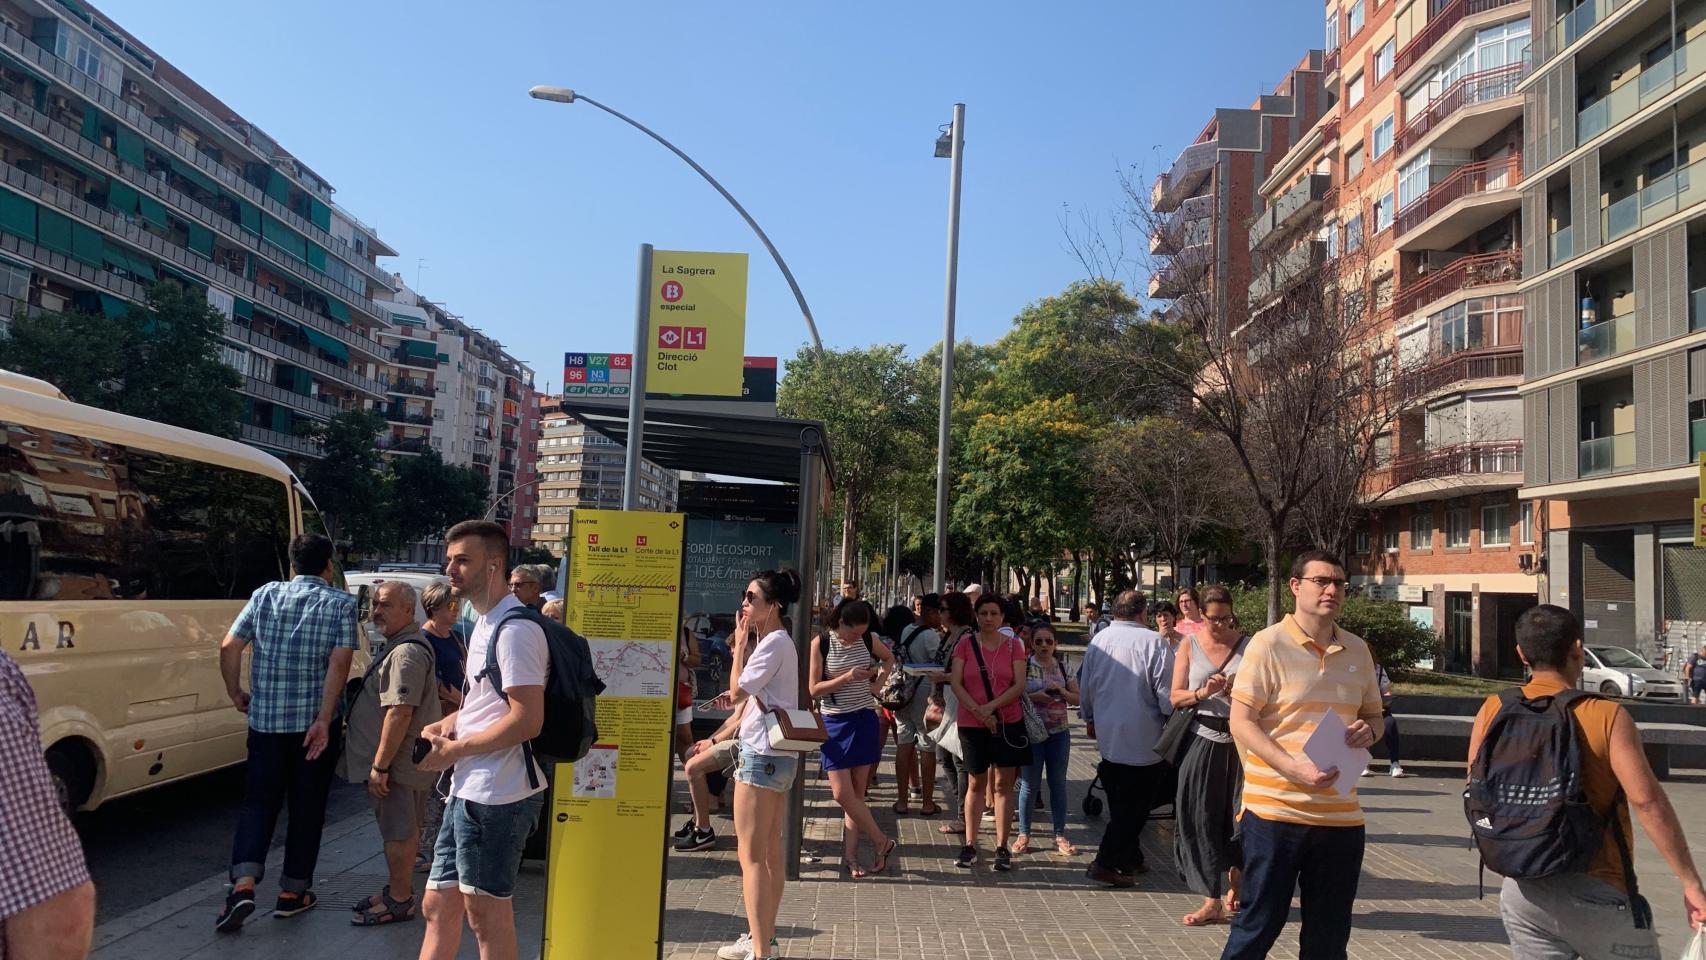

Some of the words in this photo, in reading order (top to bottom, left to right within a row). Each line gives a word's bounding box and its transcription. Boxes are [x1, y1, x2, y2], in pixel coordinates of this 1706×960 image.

[662, 265, 674, 274] La
[676, 265, 715, 276] Sagrera
[666, 284, 679, 299] B
[660, 303, 696, 312] especial
[687, 331, 703, 345] L1
[569, 356, 583, 365] H8
[588, 356, 608, 365] V27
[614, 357, 627, 366] 62
[657, 352, 698, 362] Direcció
[657, 362, 678, 371] Clot
[569, 370, 583, 380] 96
[591, 370, 604, 379] N3
[588, 545, 600, 553] Tall
[635, 547, 654, 555] Corte
[655, 547, 664, 555] de
[716, 544, 774, 556] ECOSPORT
[687, 555, 725, 564] OTALMENT
